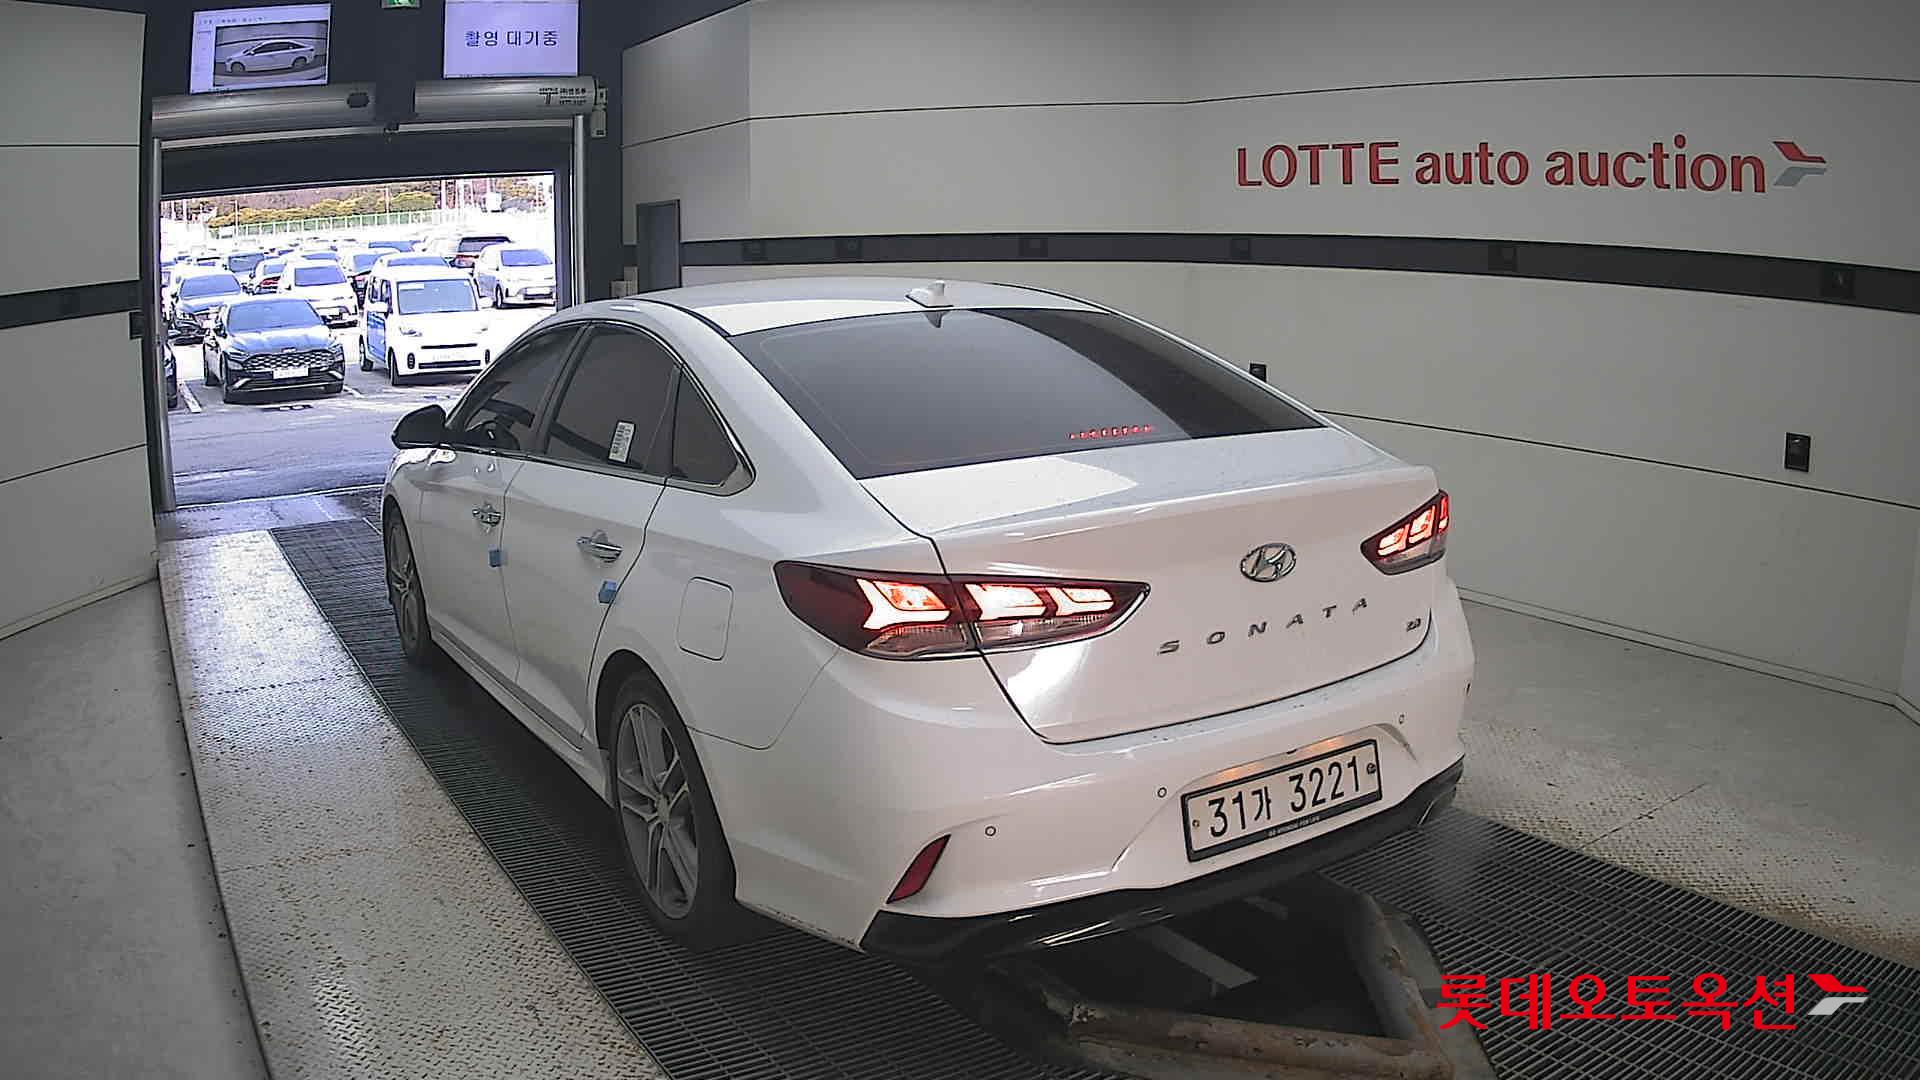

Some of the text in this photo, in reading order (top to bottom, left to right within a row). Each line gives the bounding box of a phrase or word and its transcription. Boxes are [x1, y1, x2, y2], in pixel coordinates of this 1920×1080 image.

[464, 30, 559, 47] 촬영 대기중
[1237, 134, 1766, 193] LOTTE auto auction
[1157, 598, 1368, 656] SONATA
[1208, 756, 1360, 838] 31가 3221
